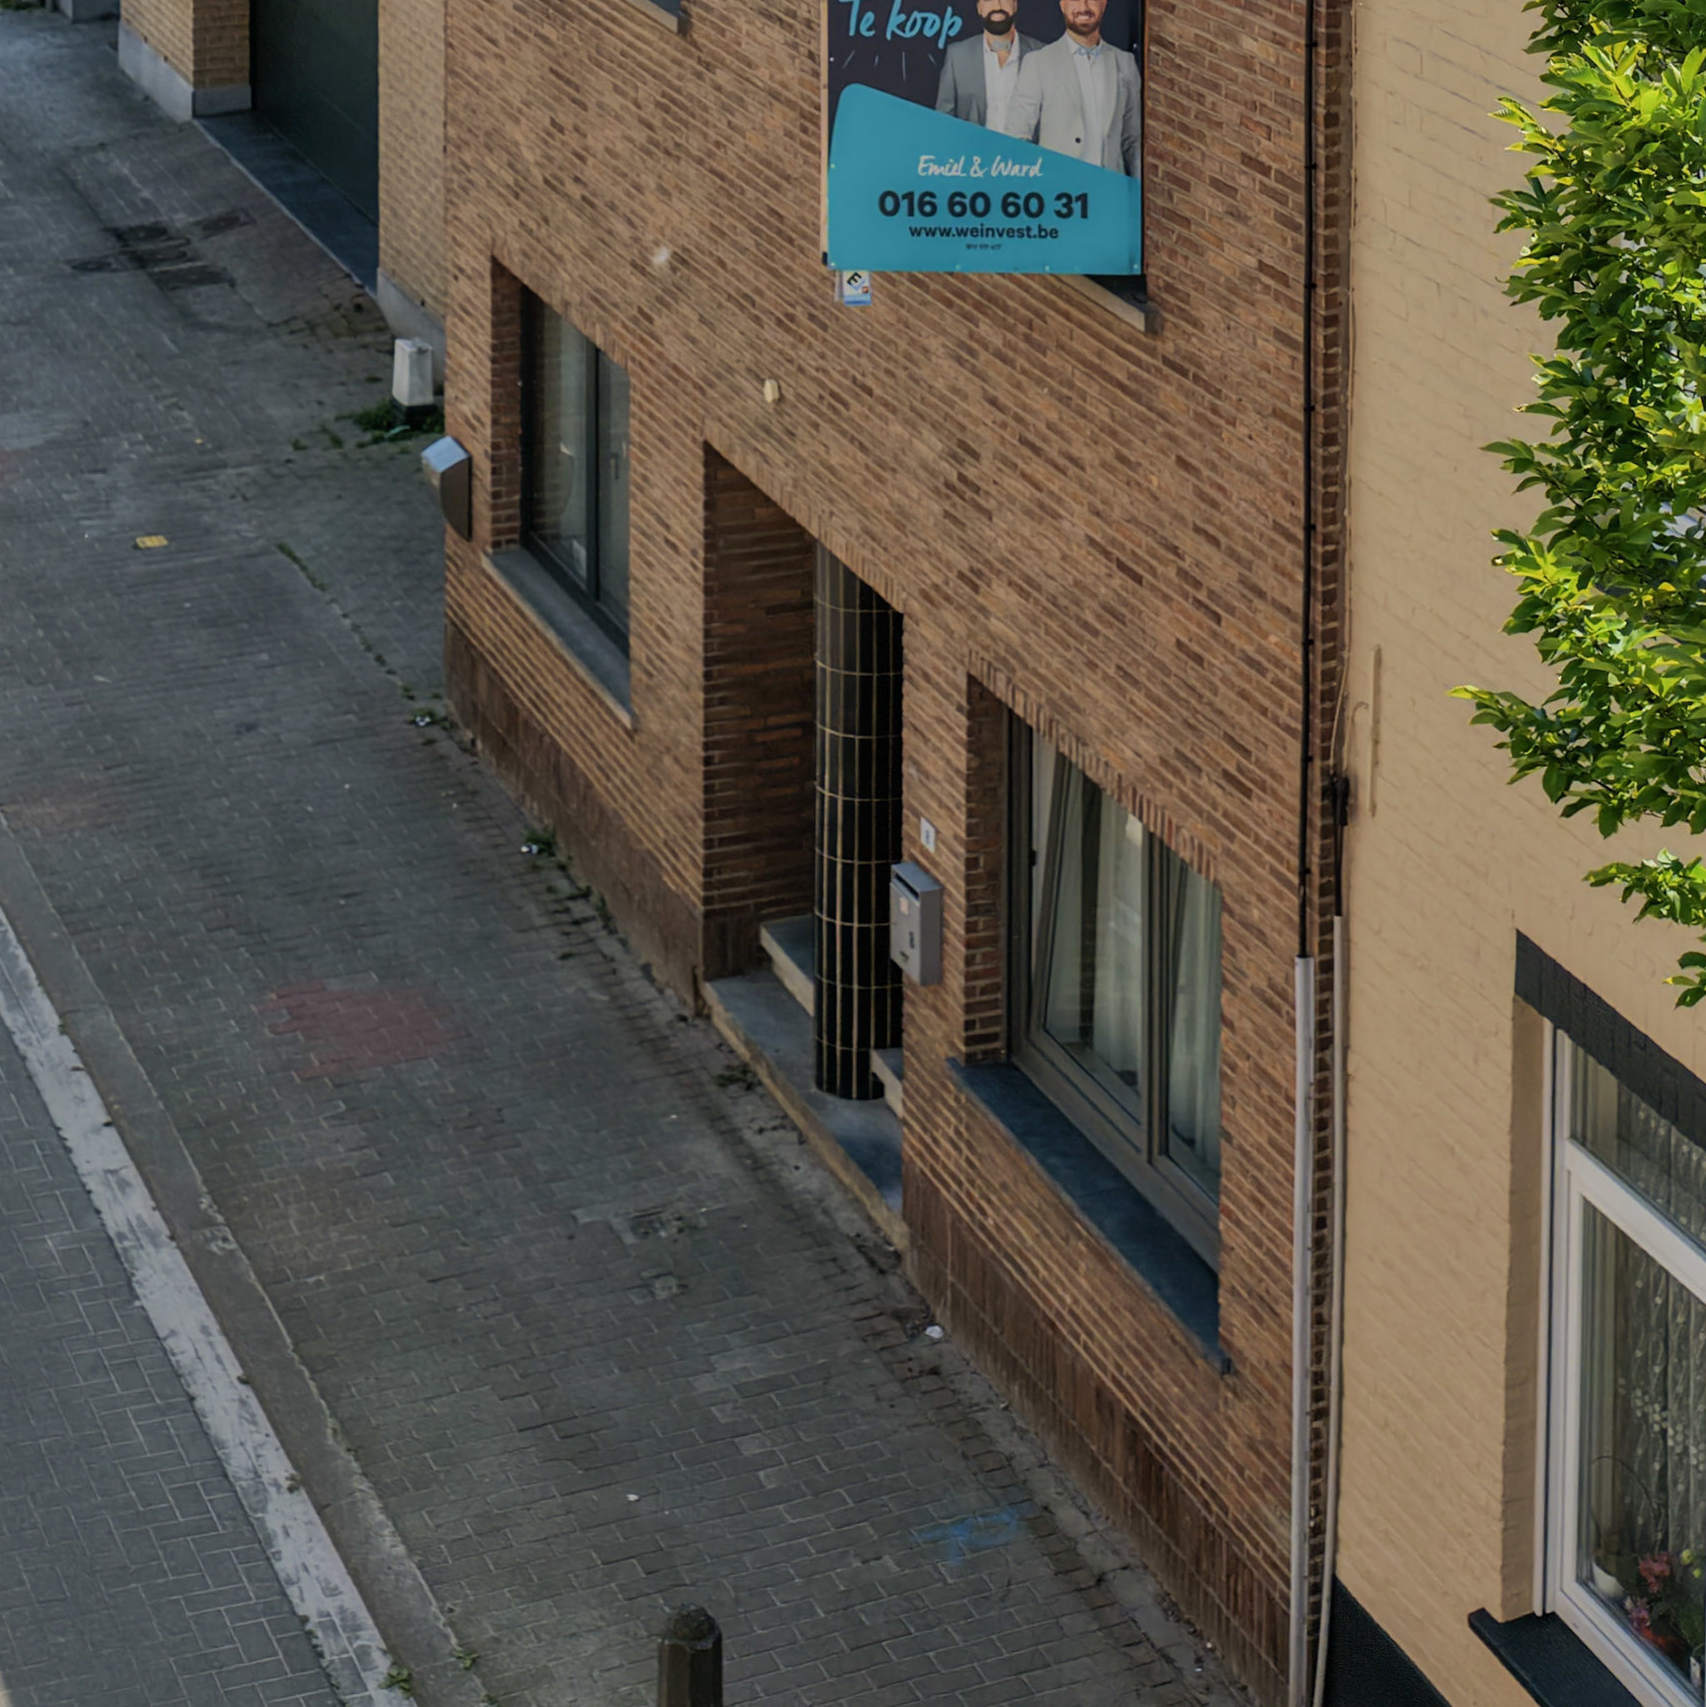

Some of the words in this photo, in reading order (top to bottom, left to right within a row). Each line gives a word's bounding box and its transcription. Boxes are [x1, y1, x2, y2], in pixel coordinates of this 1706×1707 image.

[918, 155, 966, 178] Emiel
[970, 156, 988, 177] &
[991, 155, 1044, 177] Ward
[879, 190, 938, 218] 016
[947, 191, 991, 218] 60
[1001, 191, 1045, 219] 60
[1053, 192, 1089, 219] 31
[909, 223, 1059, 240] www.weinvest.be
